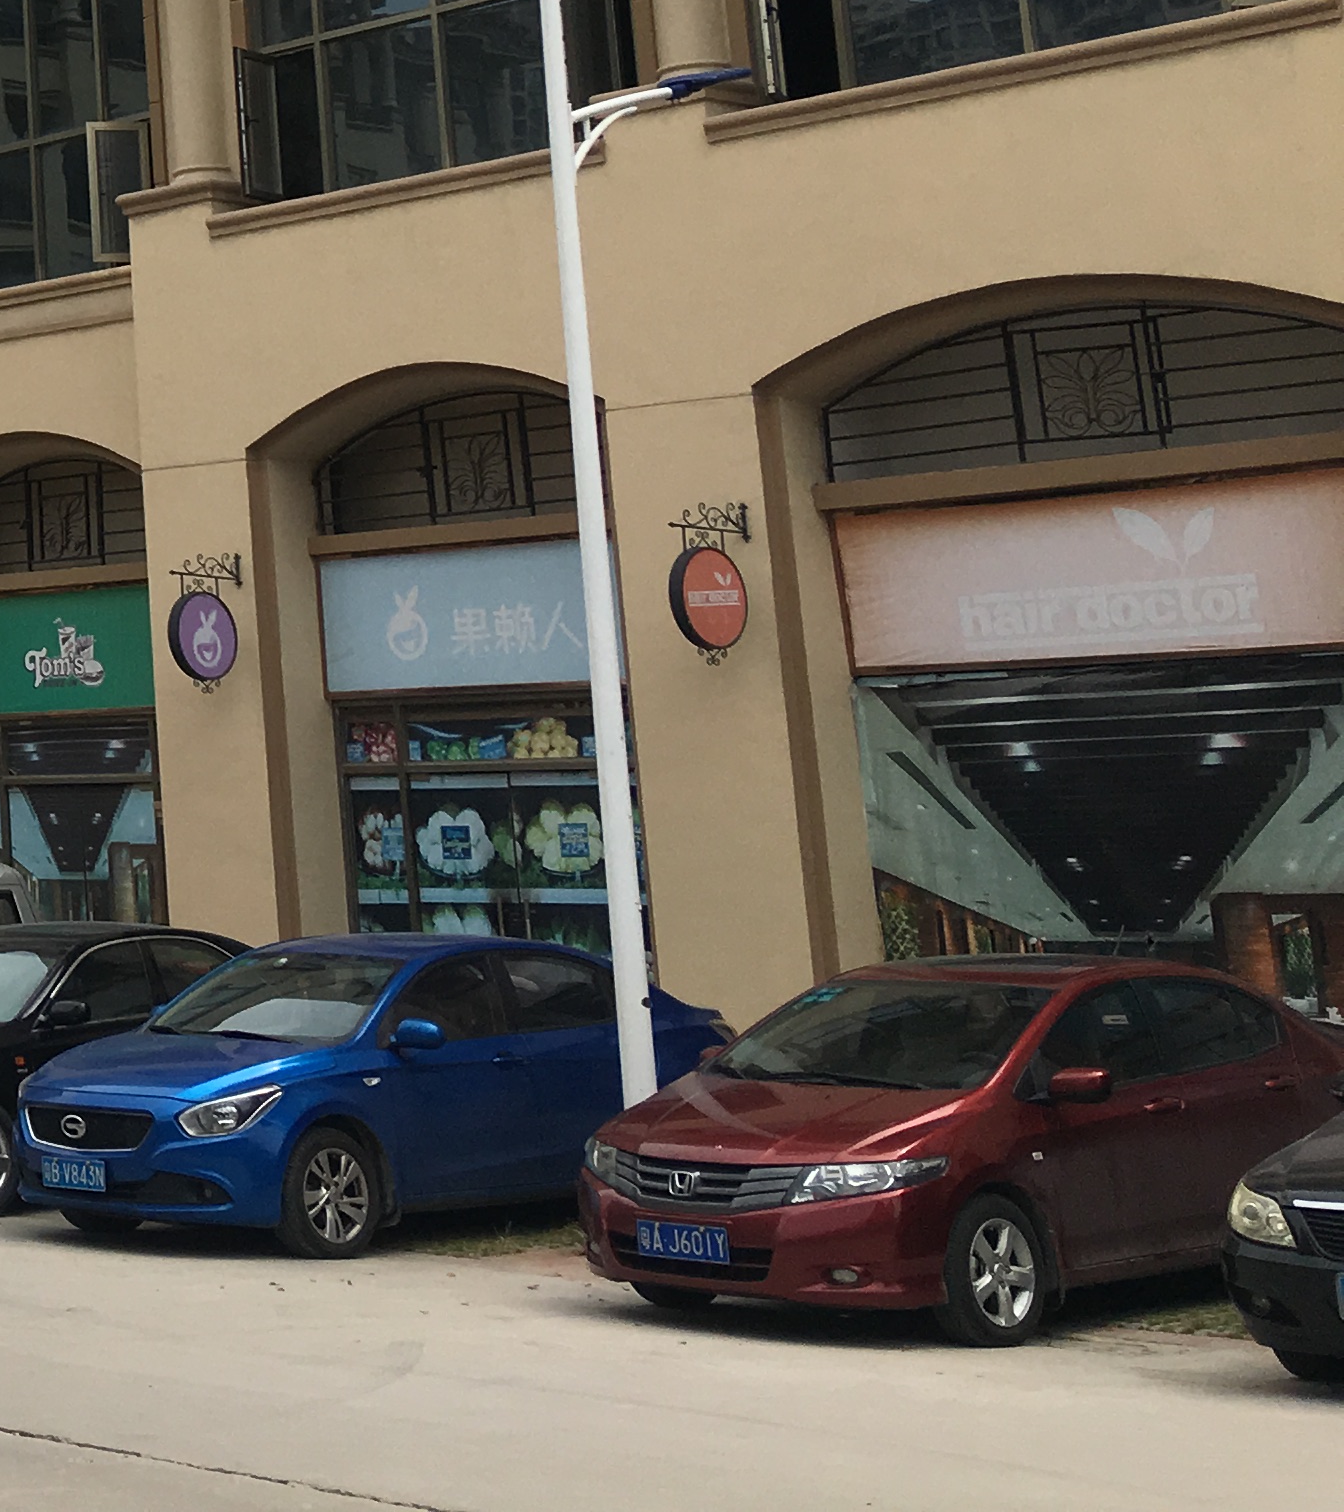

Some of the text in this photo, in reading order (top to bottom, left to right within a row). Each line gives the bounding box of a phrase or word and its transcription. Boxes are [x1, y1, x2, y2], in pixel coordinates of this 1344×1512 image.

[450, 601, 585, 656] 果赖人
[958, 581, 1259, 638] hair doctor
[24, 647, 85, 688] Tom's
